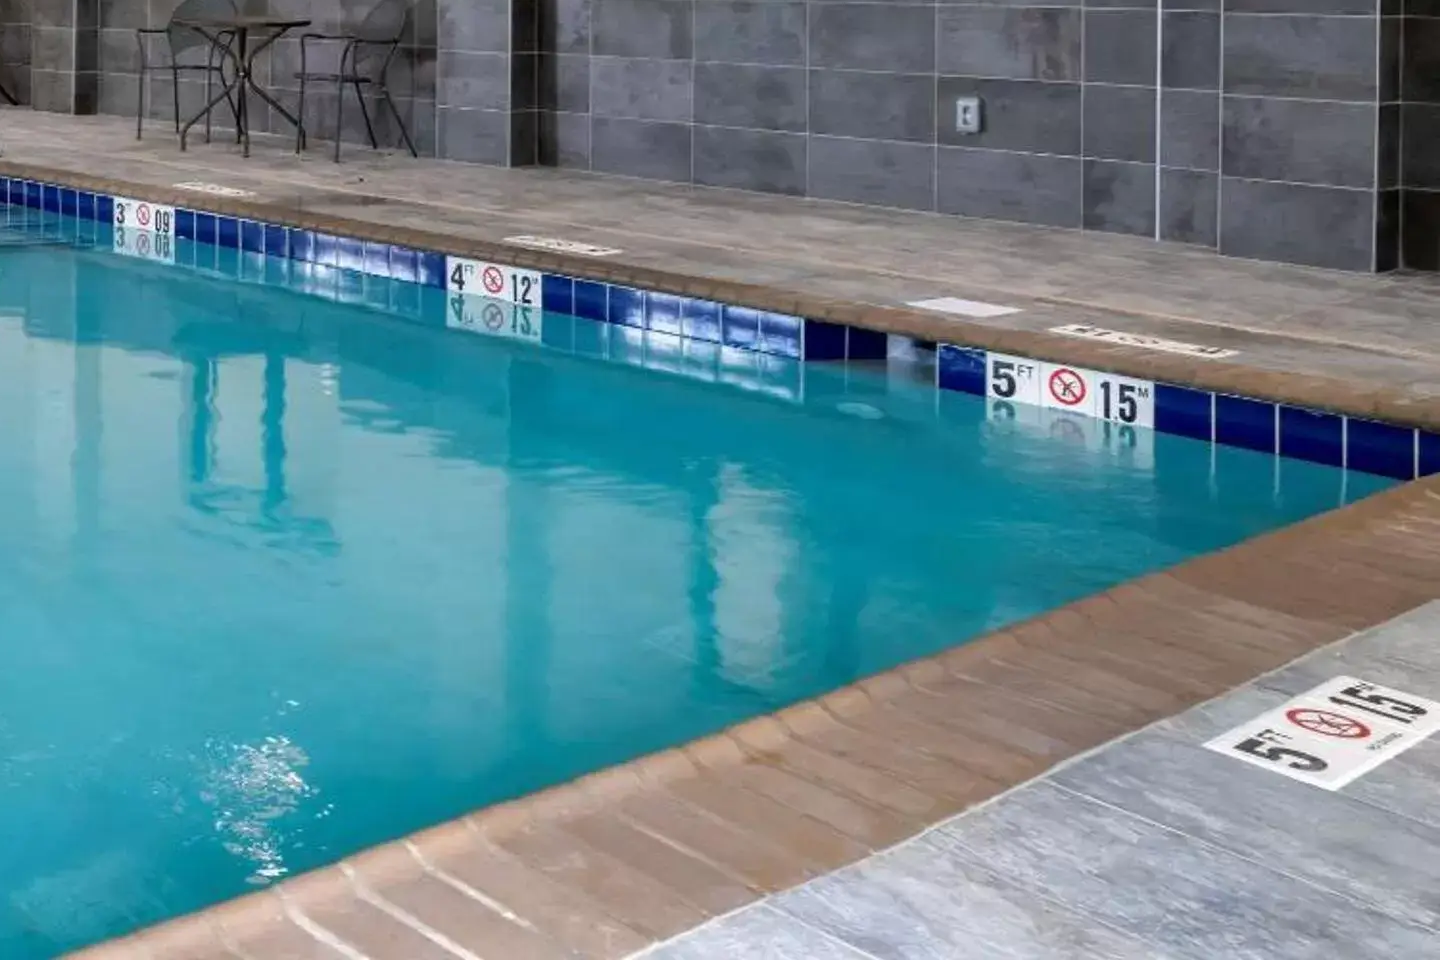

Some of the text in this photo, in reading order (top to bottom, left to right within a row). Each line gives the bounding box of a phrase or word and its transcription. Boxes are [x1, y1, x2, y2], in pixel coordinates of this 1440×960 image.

[116, 203, 125, 224] 3
[451, 263, 465, 290] 4
[992, 360, 1016, 398] 5
[1017, 364, 1034, 378] FT
[1233, 738, 1328, 772] 5
